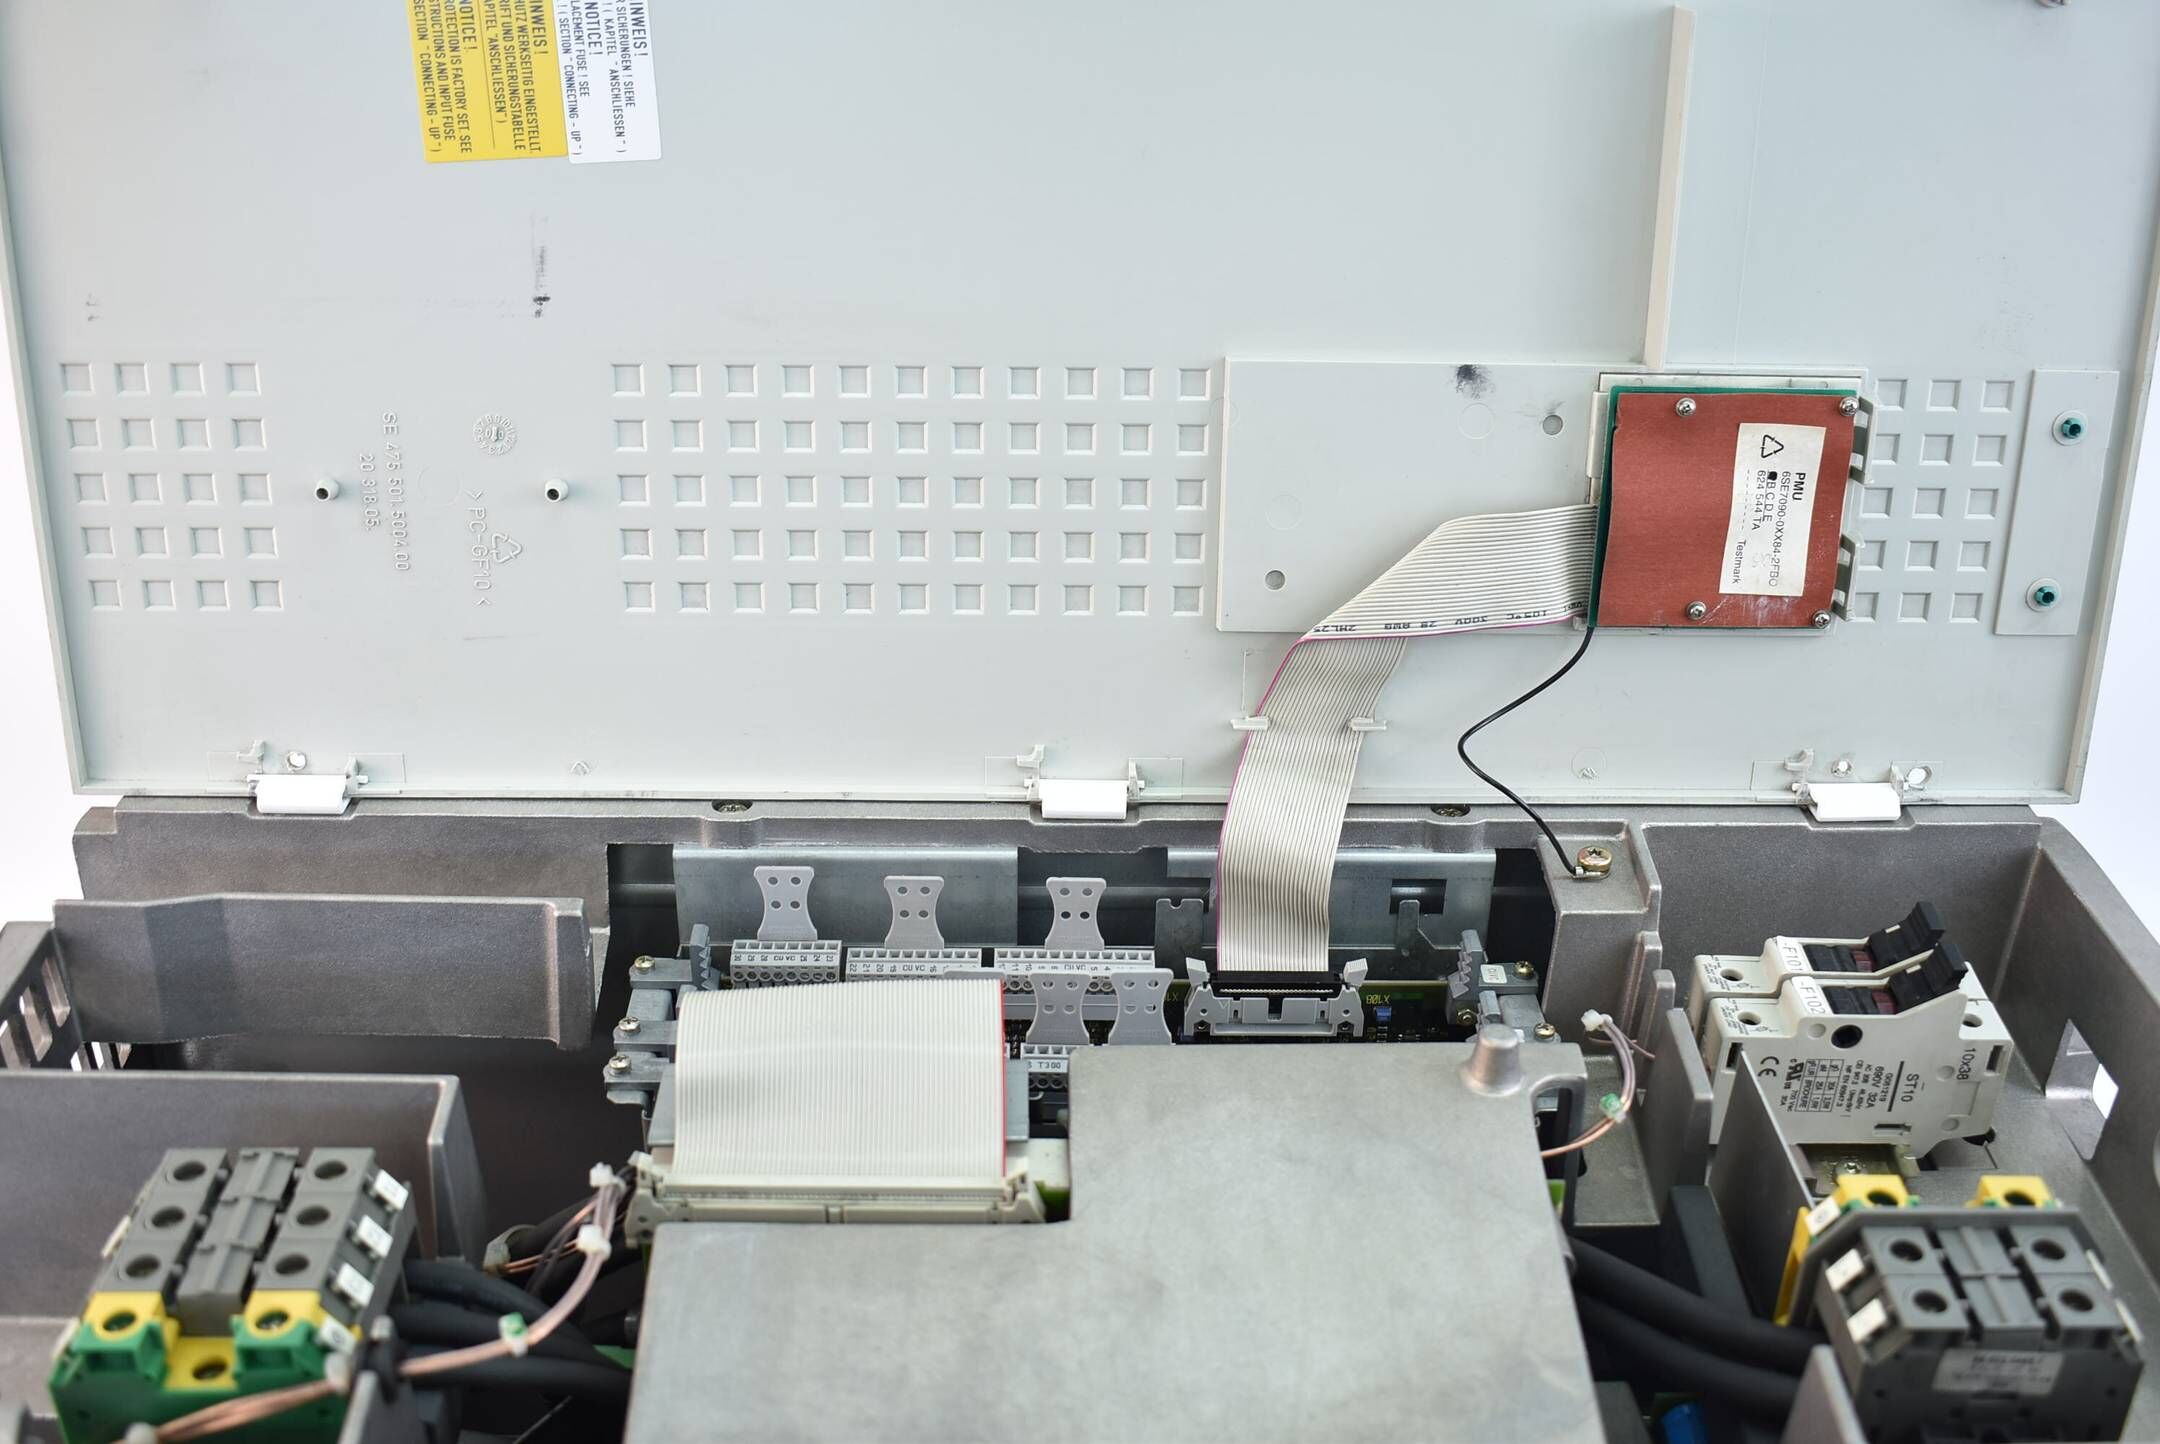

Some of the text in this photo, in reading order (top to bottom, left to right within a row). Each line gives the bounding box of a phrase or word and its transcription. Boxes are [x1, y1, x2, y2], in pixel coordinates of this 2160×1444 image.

[413, 0, 432, 41] SECTION
[503, 22, 515, 42] UND
[571, 1, 584, 45] LACEMENT
[559, 18, 571, 54] SECTION
[605, 19, 616, 55] KAPITEL
[617, 7, 632, 71] SICHERUNGEN
[451, 56, 464, 64] IS
[516, 25, 534, 85] WERKSEITIG
[575, 50, 587, 71] FUSE
[420, 53, 438, 116] CONNECTING
[436, 61, 450, 81] AND
[438, 84, 453, 113] INPUT
[452, 68, 469, 111] FACTORY
[504, 45, 525, 150] SICHERUNGSTABELLE
[564, 65, 580, 119] CONNECTING
[579, 81, 589, 97] SEE
[624, 81, 635, 108] SIEHE
[428, 127, 440, 140] UP
[443, 116, 455, 140] FUSE
[570, 131, 581, 142] UP
[460, 136, 472, 153] SEE
[382, 412, 398, 435] SE
[359, 453, 375, 472] 20
[1751, 470, 1766, 530] 624 544 TA
[1765, 492, 1775, 500] C
[1792, 472, 1806, 501] PMU
[1732, 540, 1746, 584] Testmark
[1454, 614, 1488, 626] 300V
[1956, 1047, 1976, 1080] 10x38
[1866, 1092, 1877, 1108] 32A
[1901, 1073, 1919, 1102] ST10
